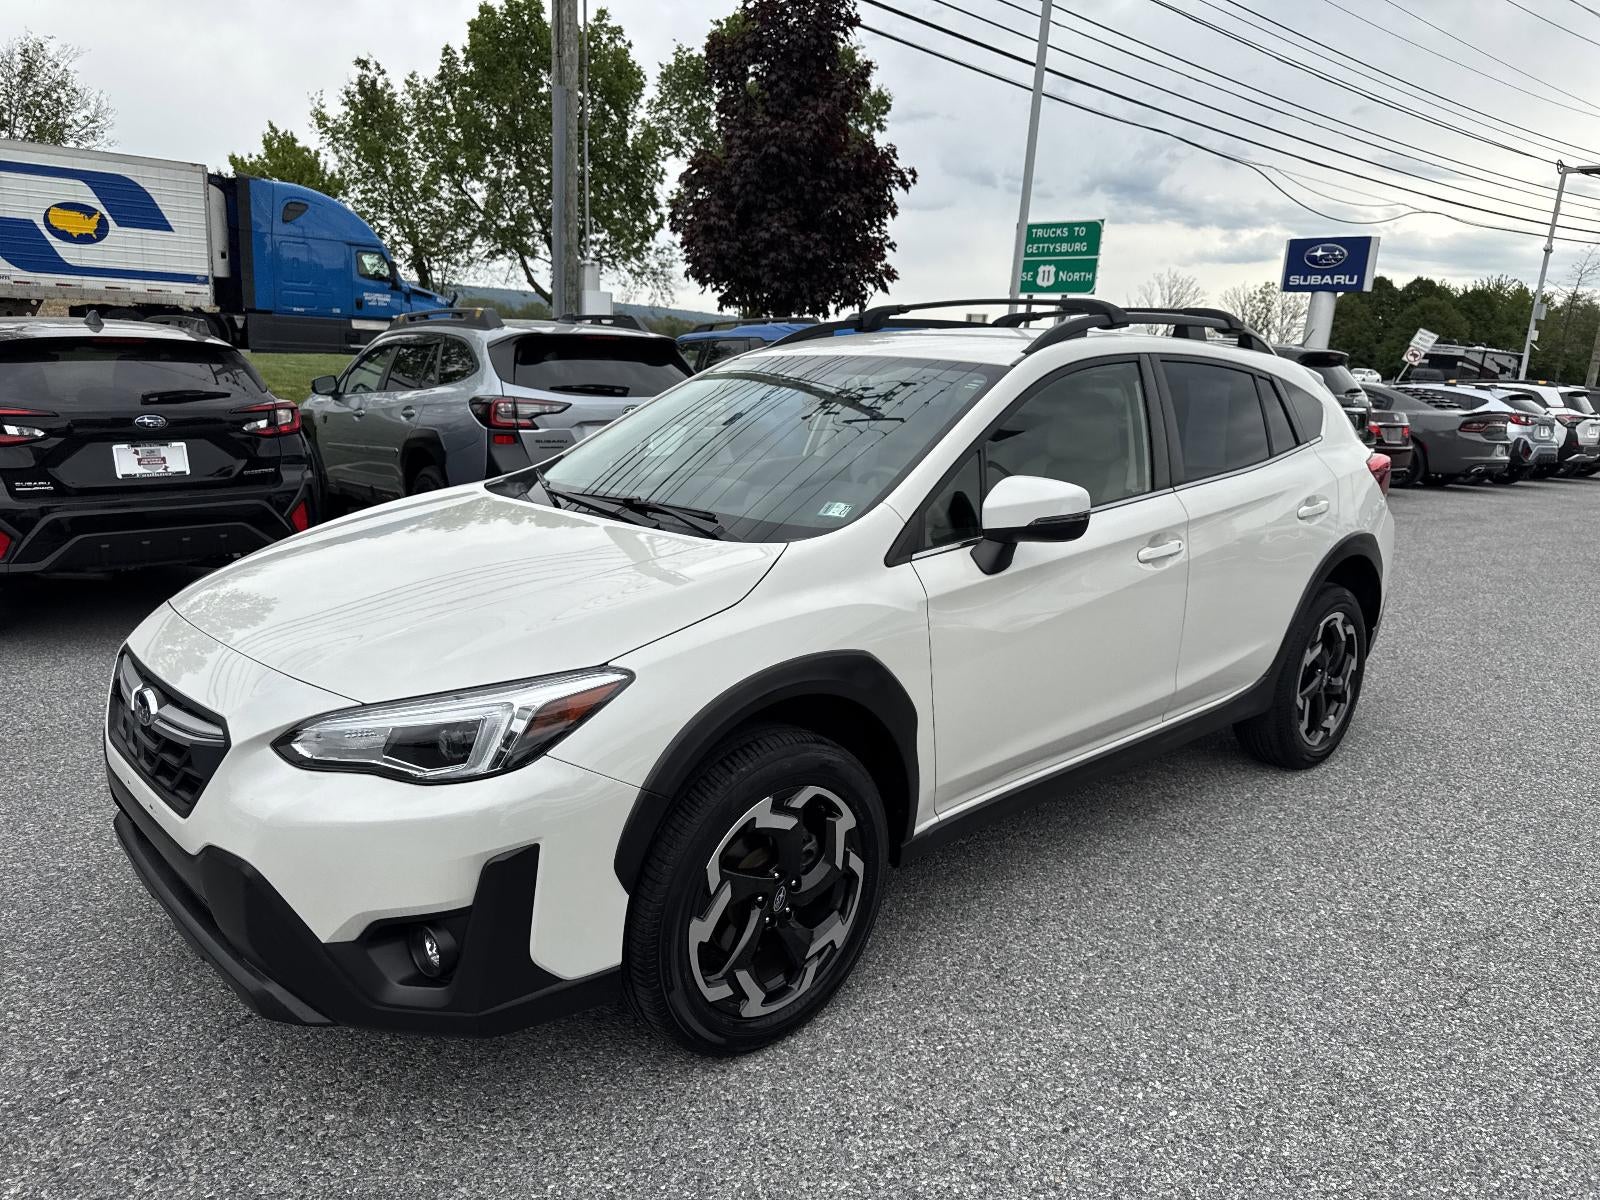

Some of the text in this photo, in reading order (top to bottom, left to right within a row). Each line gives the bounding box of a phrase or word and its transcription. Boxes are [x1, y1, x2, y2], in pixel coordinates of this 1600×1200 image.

[1032, 226, 1086, 238] TRUCKS TO
[1026, 242, 1088, 253] GETTYSBURG
[1021, 271, 1034, 281] SE
[1041, 269, 1051, 283] 11
[1288, 274, 1358, 285] SUBARU
